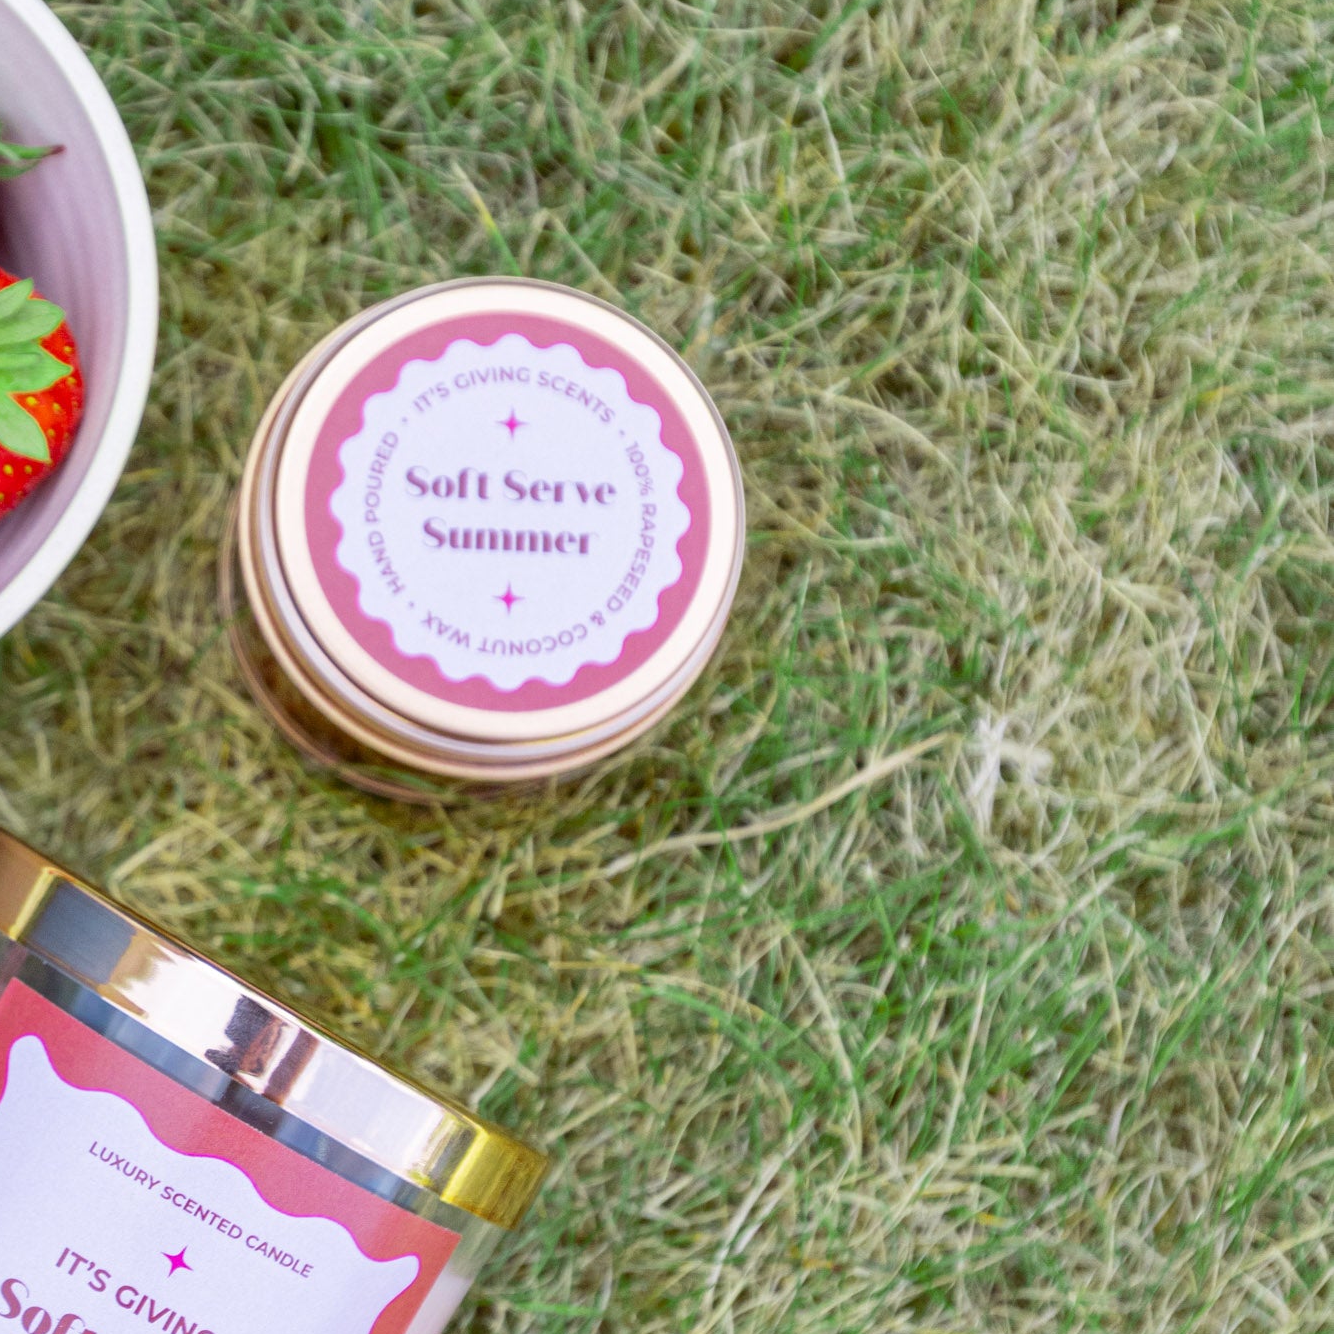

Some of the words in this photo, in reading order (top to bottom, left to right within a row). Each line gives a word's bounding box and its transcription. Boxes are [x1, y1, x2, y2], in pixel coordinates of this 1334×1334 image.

[454, 366, 531, 390] GIVING
[537, 370, 616, 423] SCENTS
[365, 431, 399, 523] POURED
[406, 466, 489, 500] Soft
[503, 470, 617, 505] Serve
[625, 441, 654, 496] 100%
[368, 530, 406, 595] HAND
[422, 516, 600, 555] Summer
[606, 503, 657, 612] RAPESEED
[421, 610, 471, 649] WAX
[478, 623, 588, 656] COCONUT
[590, 610, 606, 626] &
[88, 1141, 161, 1190] LUXURY
[160, 1186, 243, 1240] SCENTED
[245, 1235, 314, 1279] CANDLE
